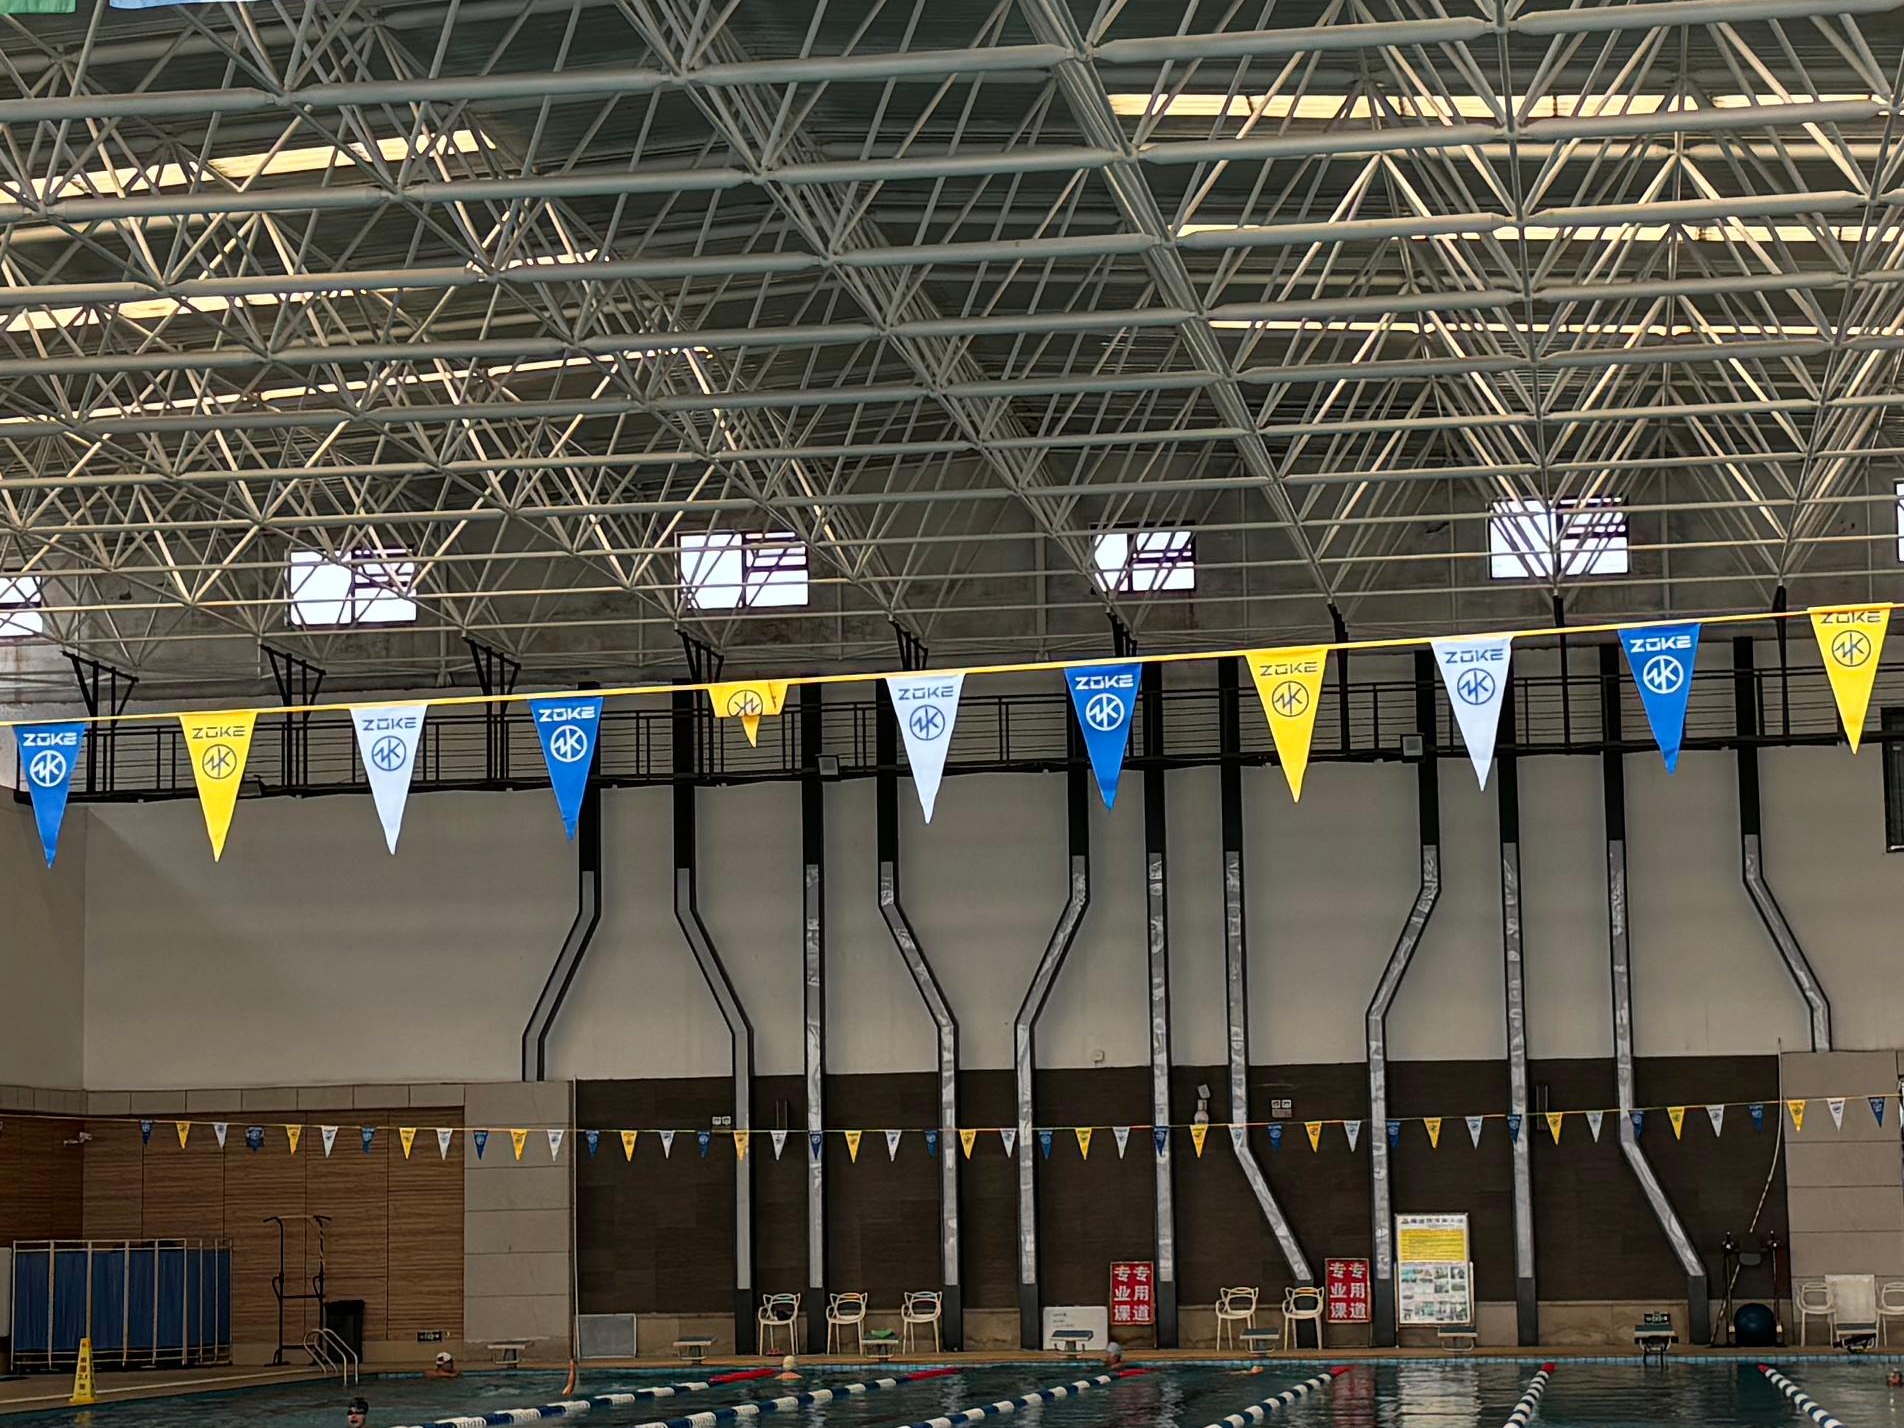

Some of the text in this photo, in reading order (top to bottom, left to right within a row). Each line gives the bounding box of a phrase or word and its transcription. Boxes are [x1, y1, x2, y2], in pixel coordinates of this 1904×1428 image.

[1630, 637, 1691, 652] ZOKE
[1444, 649, 1504, 665] ZOKE
[1258, 662, 1318, 676] ZOKE
[1074, 674, 1134, 689] ZOKE
[898, 686, 954, 701] ZOKE
[538, 707, 596, 722] ZOKE
[362, 717, 417, 731] ZOKE
[22, 733, 77, 746] ZOKE
[192, 726, 246, 740] ZOKE
